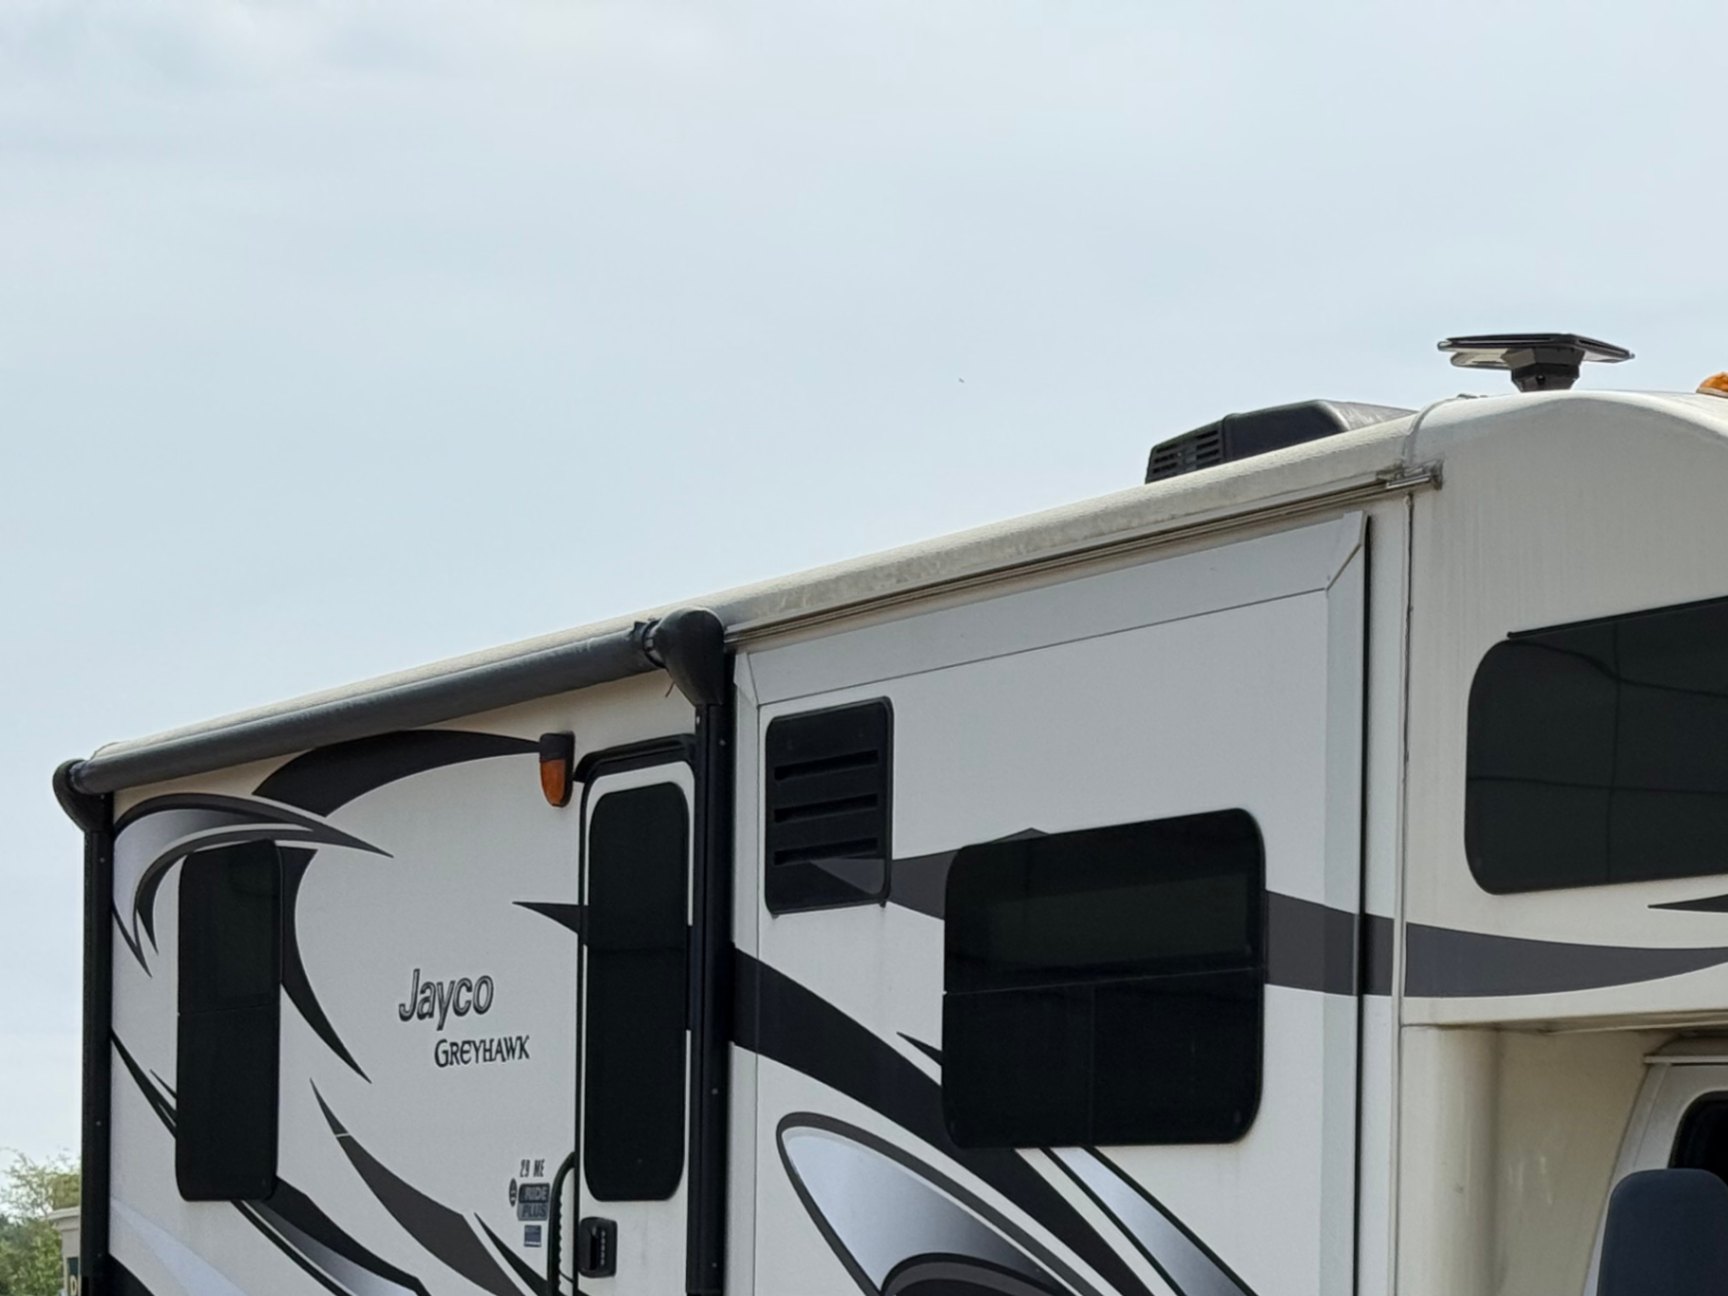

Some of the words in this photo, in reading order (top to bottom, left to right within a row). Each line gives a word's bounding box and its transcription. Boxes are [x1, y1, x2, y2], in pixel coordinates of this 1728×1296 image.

[399, 968, 494, 1031] Jayco
[434, 1035, 530, 1068] GREYHAWK
[520, 1159, 530, 1177] 29
[521, 1203, 547, 1218] PLUS
